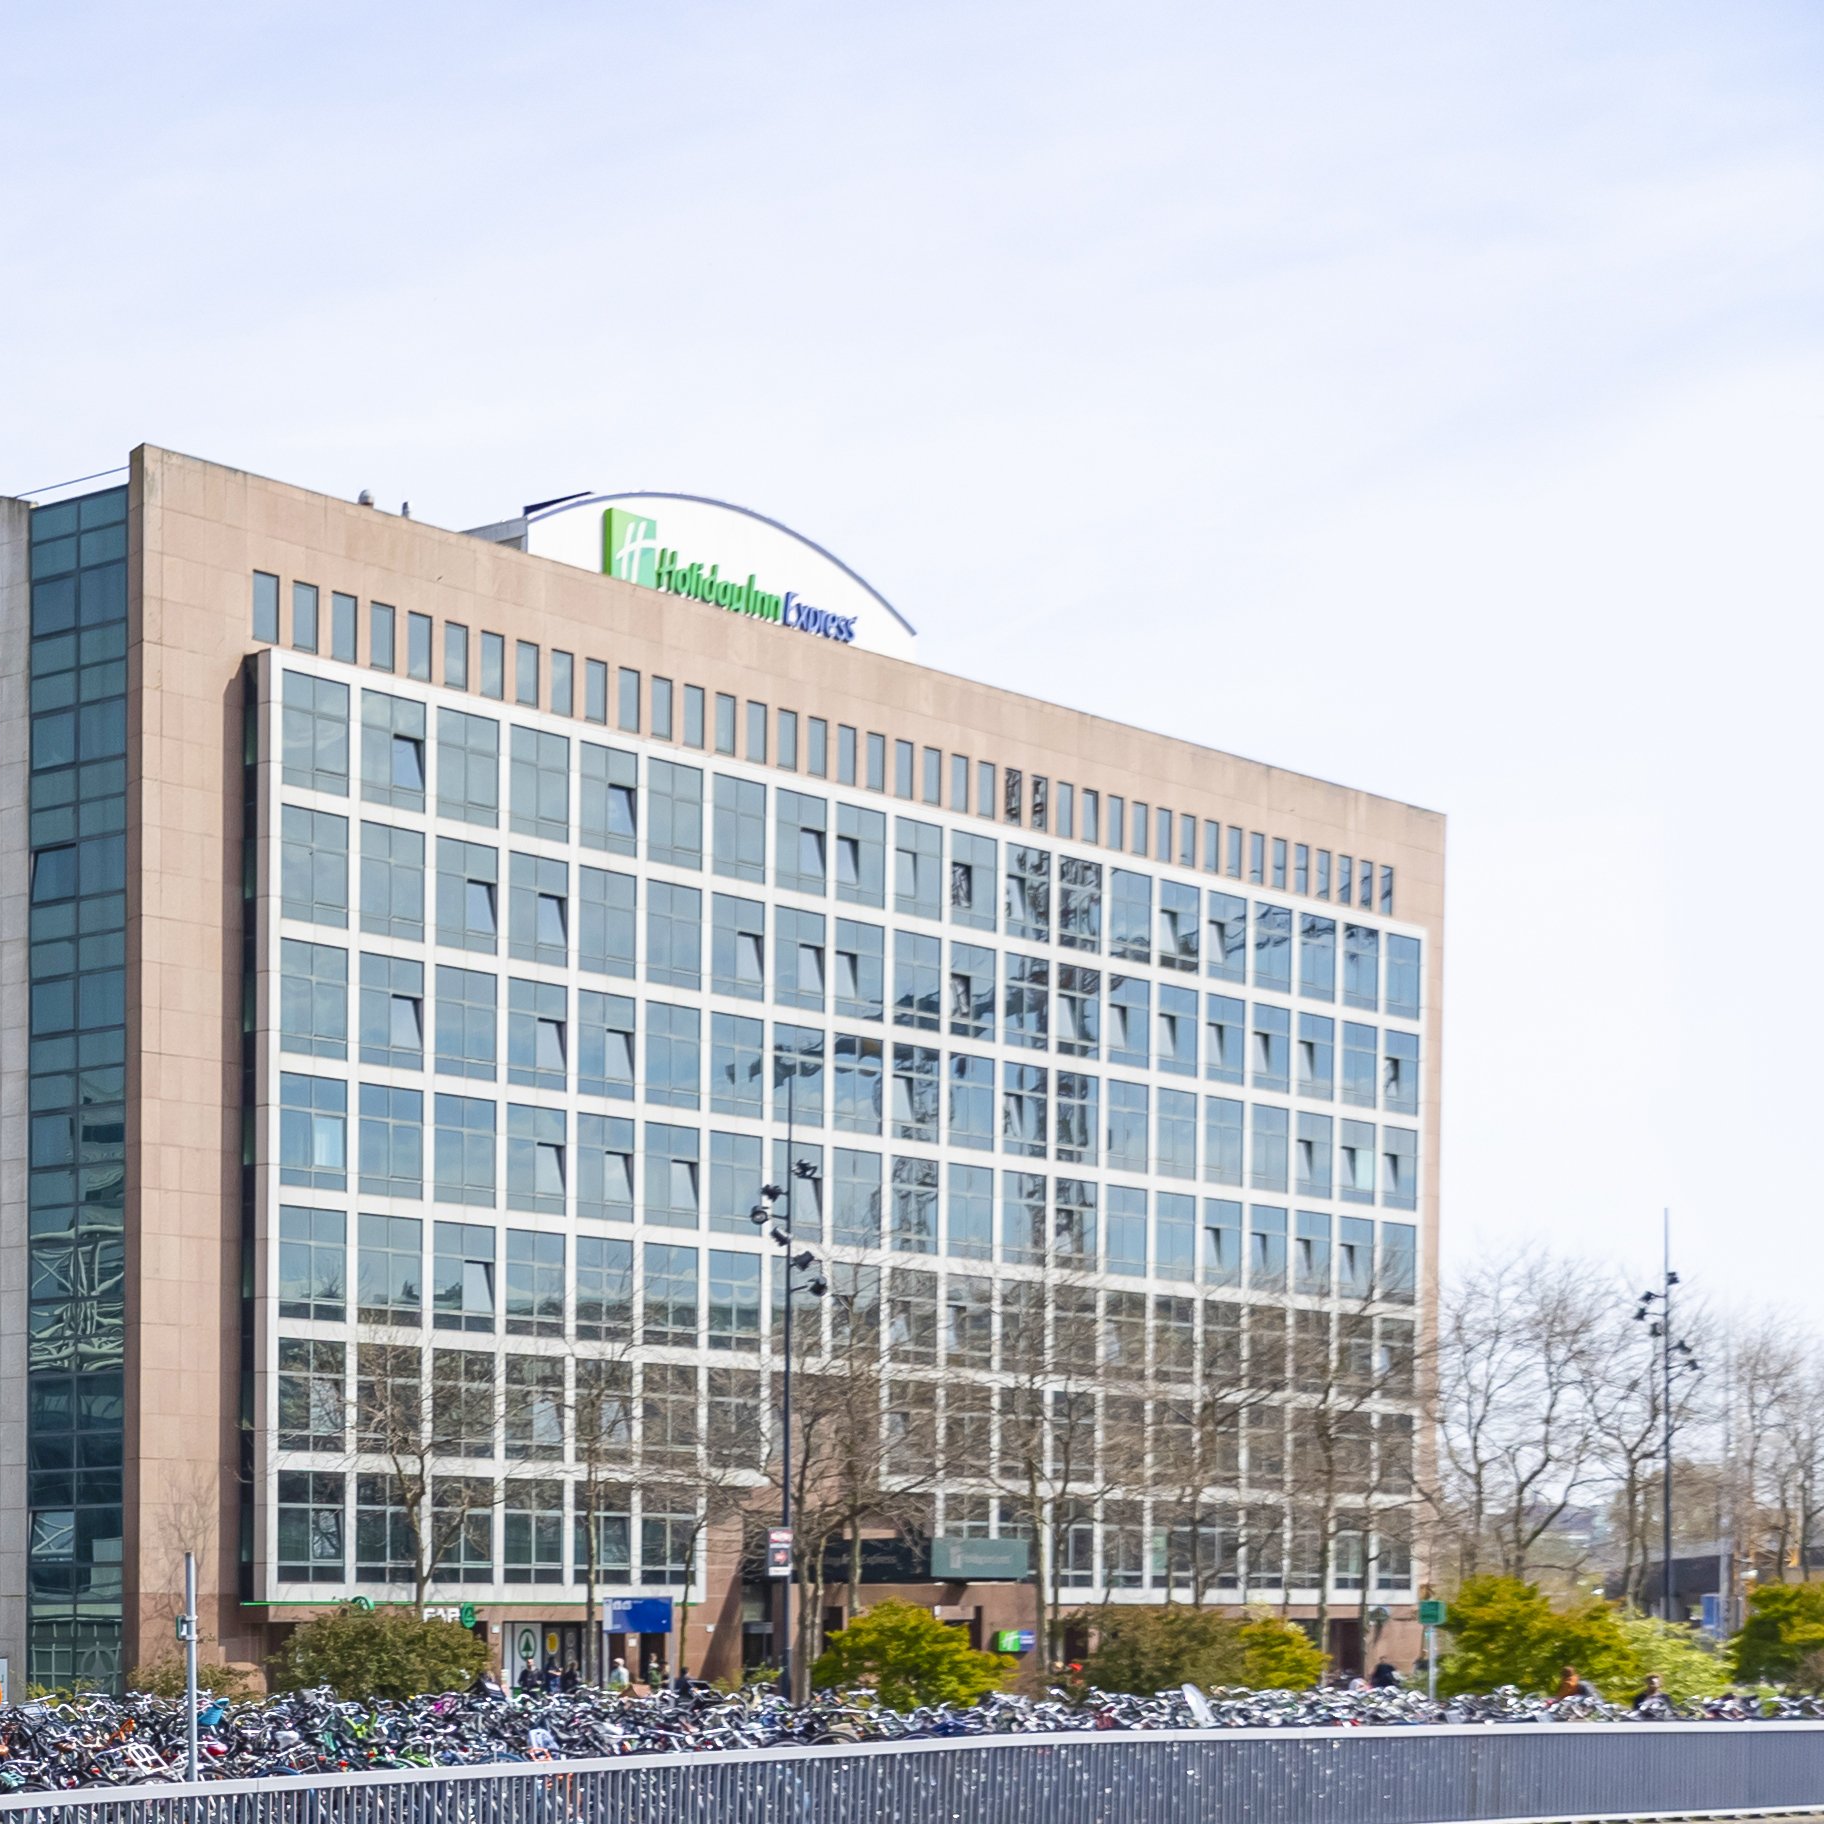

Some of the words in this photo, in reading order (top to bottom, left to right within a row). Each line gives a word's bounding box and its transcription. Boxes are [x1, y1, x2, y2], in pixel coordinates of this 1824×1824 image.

[657, 547, 743, 613] Holiday
[745, 574, 783, 622] Inn
[784, 591, 857, 643] Express
